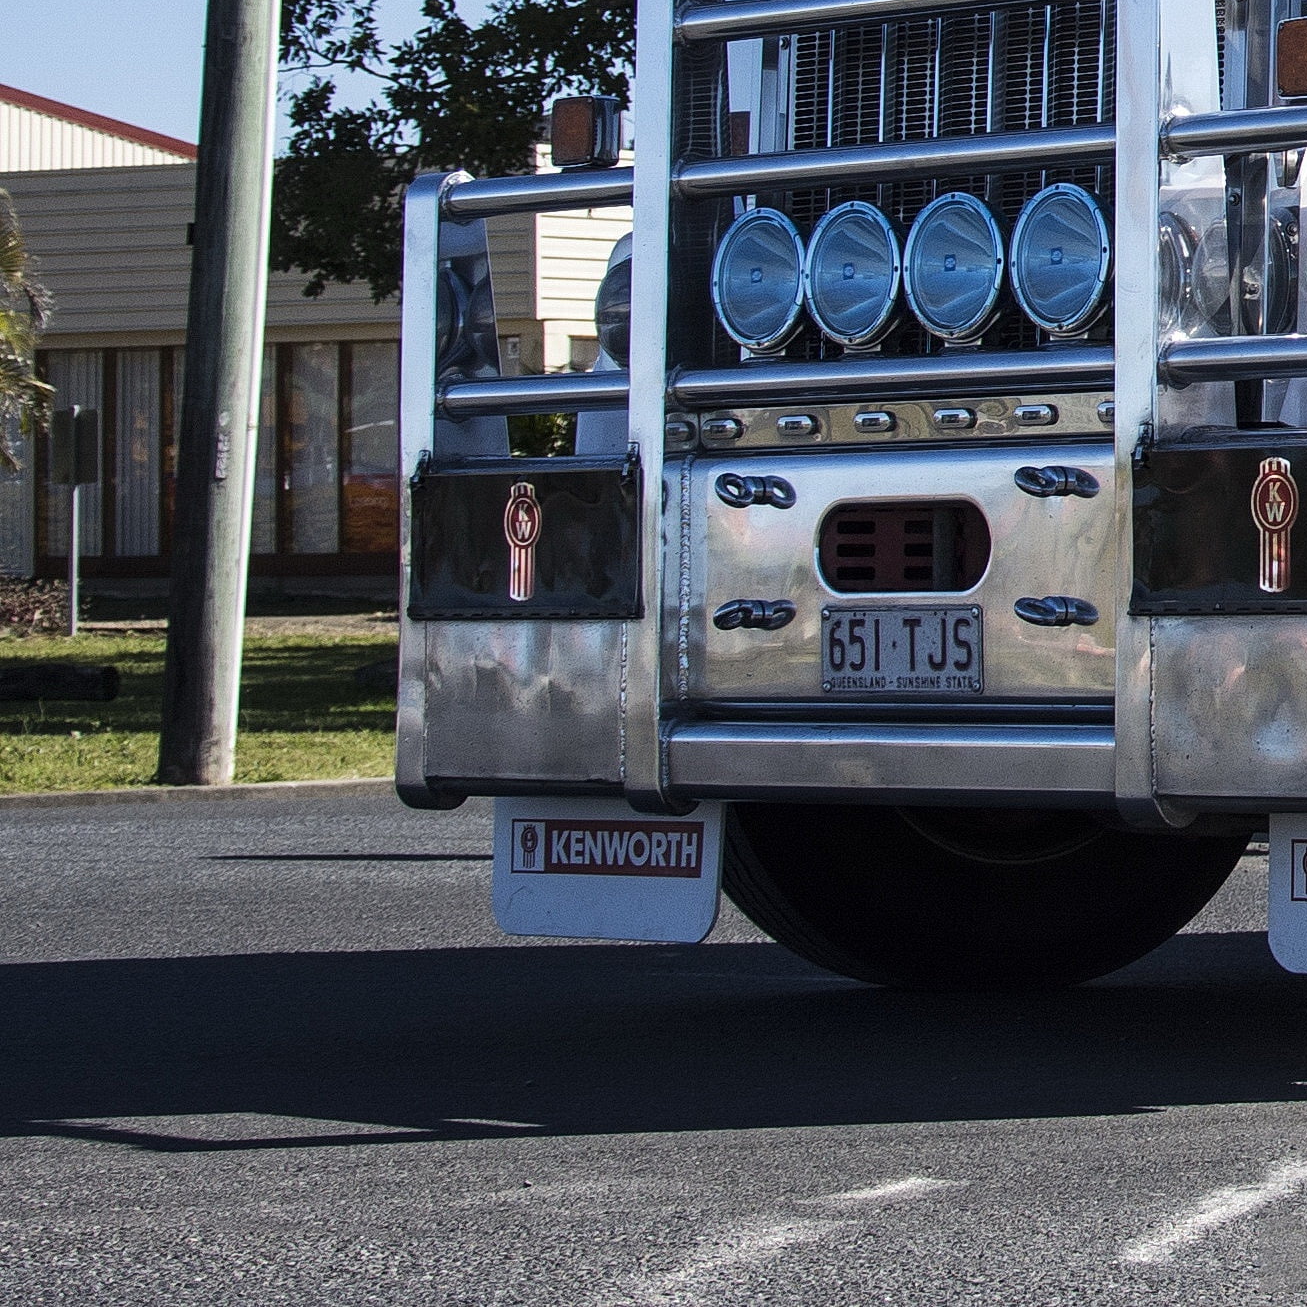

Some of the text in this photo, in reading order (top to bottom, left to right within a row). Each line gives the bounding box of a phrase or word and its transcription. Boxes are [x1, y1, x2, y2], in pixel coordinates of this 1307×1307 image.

[830, 675, 887, 690] QUEENSLAND
[895, 675, 942, 690] SUNSHINE
[551, 829, 698, 868] KENWORTH
